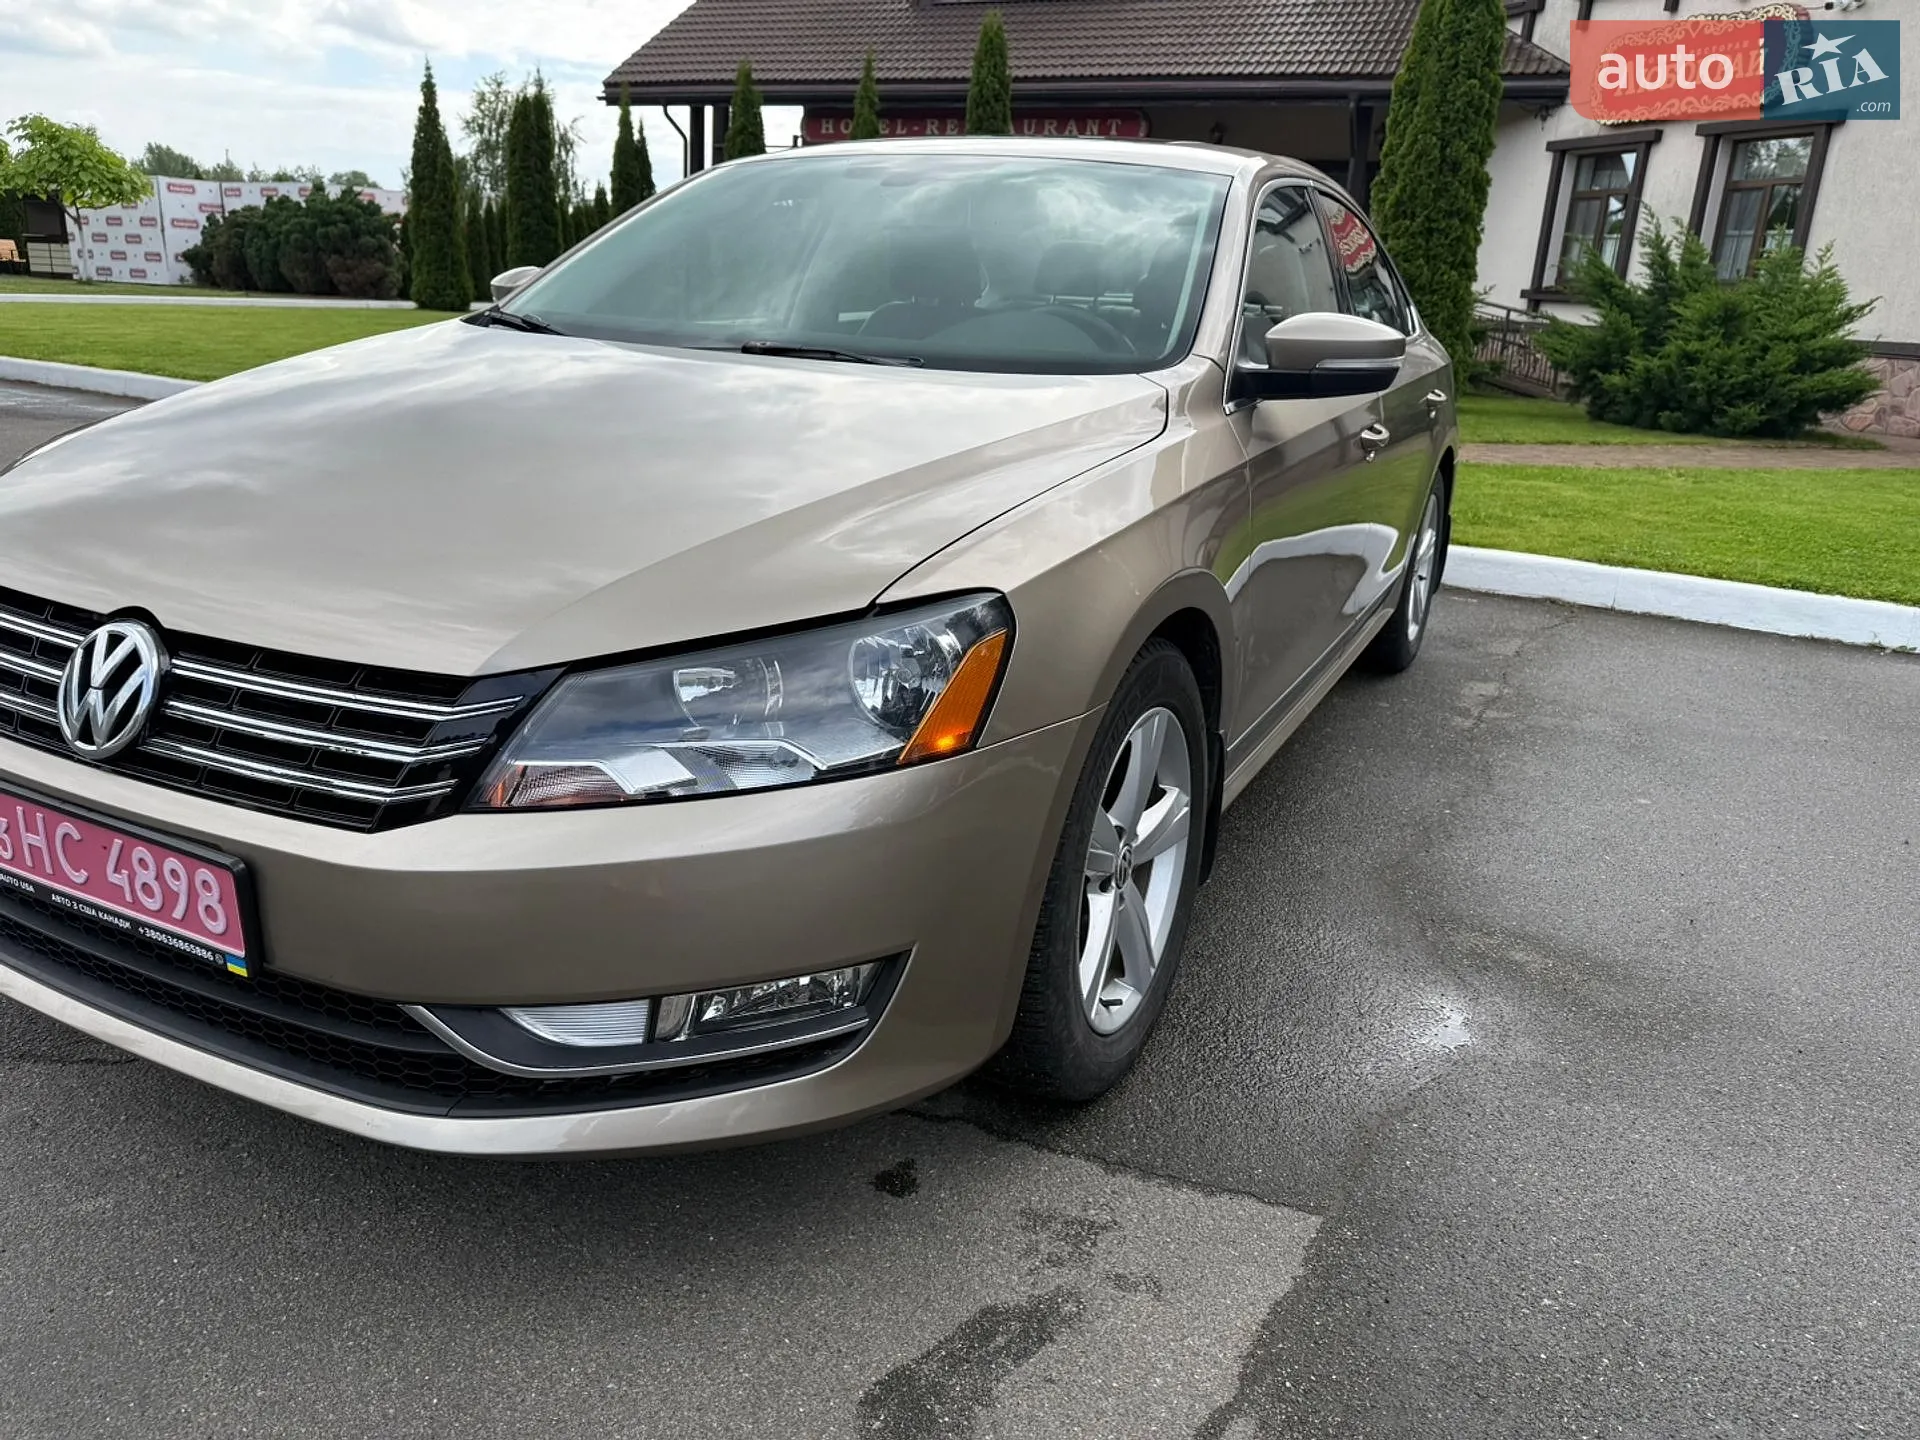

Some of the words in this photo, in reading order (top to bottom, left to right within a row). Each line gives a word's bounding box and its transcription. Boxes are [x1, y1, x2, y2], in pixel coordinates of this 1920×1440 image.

[820, 118, 1121, 136] HOEL-REURANT
[20, 881, 35, 893] USA
[106, 838, 227, 935] 4898
